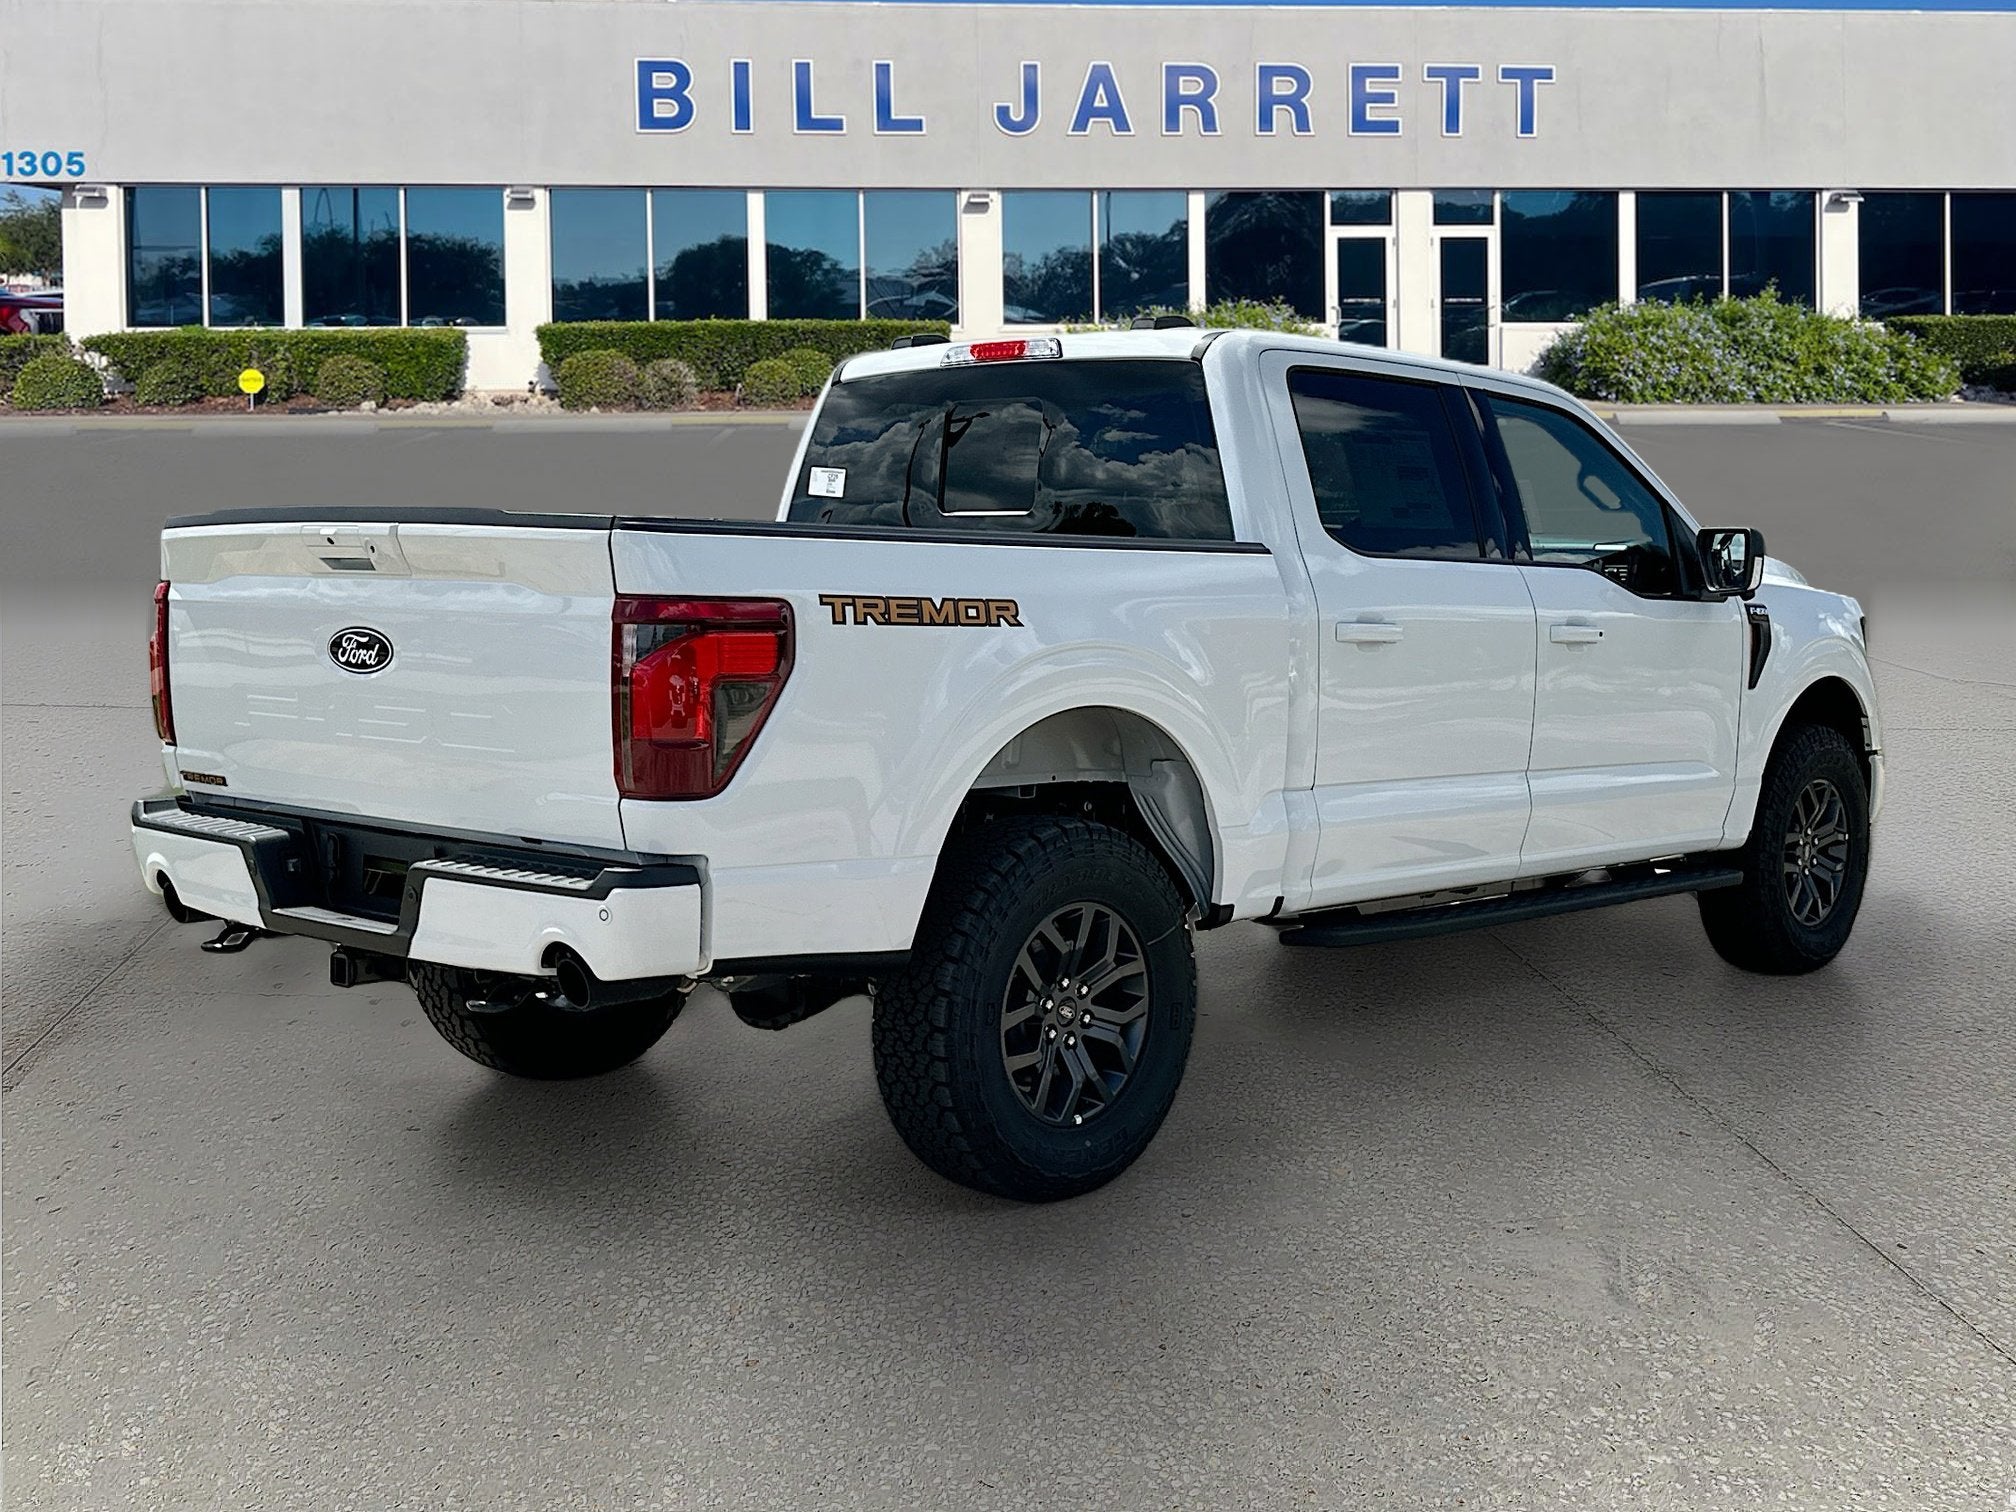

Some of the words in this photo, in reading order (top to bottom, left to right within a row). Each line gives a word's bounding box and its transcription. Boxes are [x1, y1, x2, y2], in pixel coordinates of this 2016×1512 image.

[634, 57, 926, 135] BILL
[993, 61, 1556, 138] JARRETT
[1, 151, 86, 177] 1305
[818, 593, 1025, 627] TREMOR
[337, 633, 380, 666] Ford
